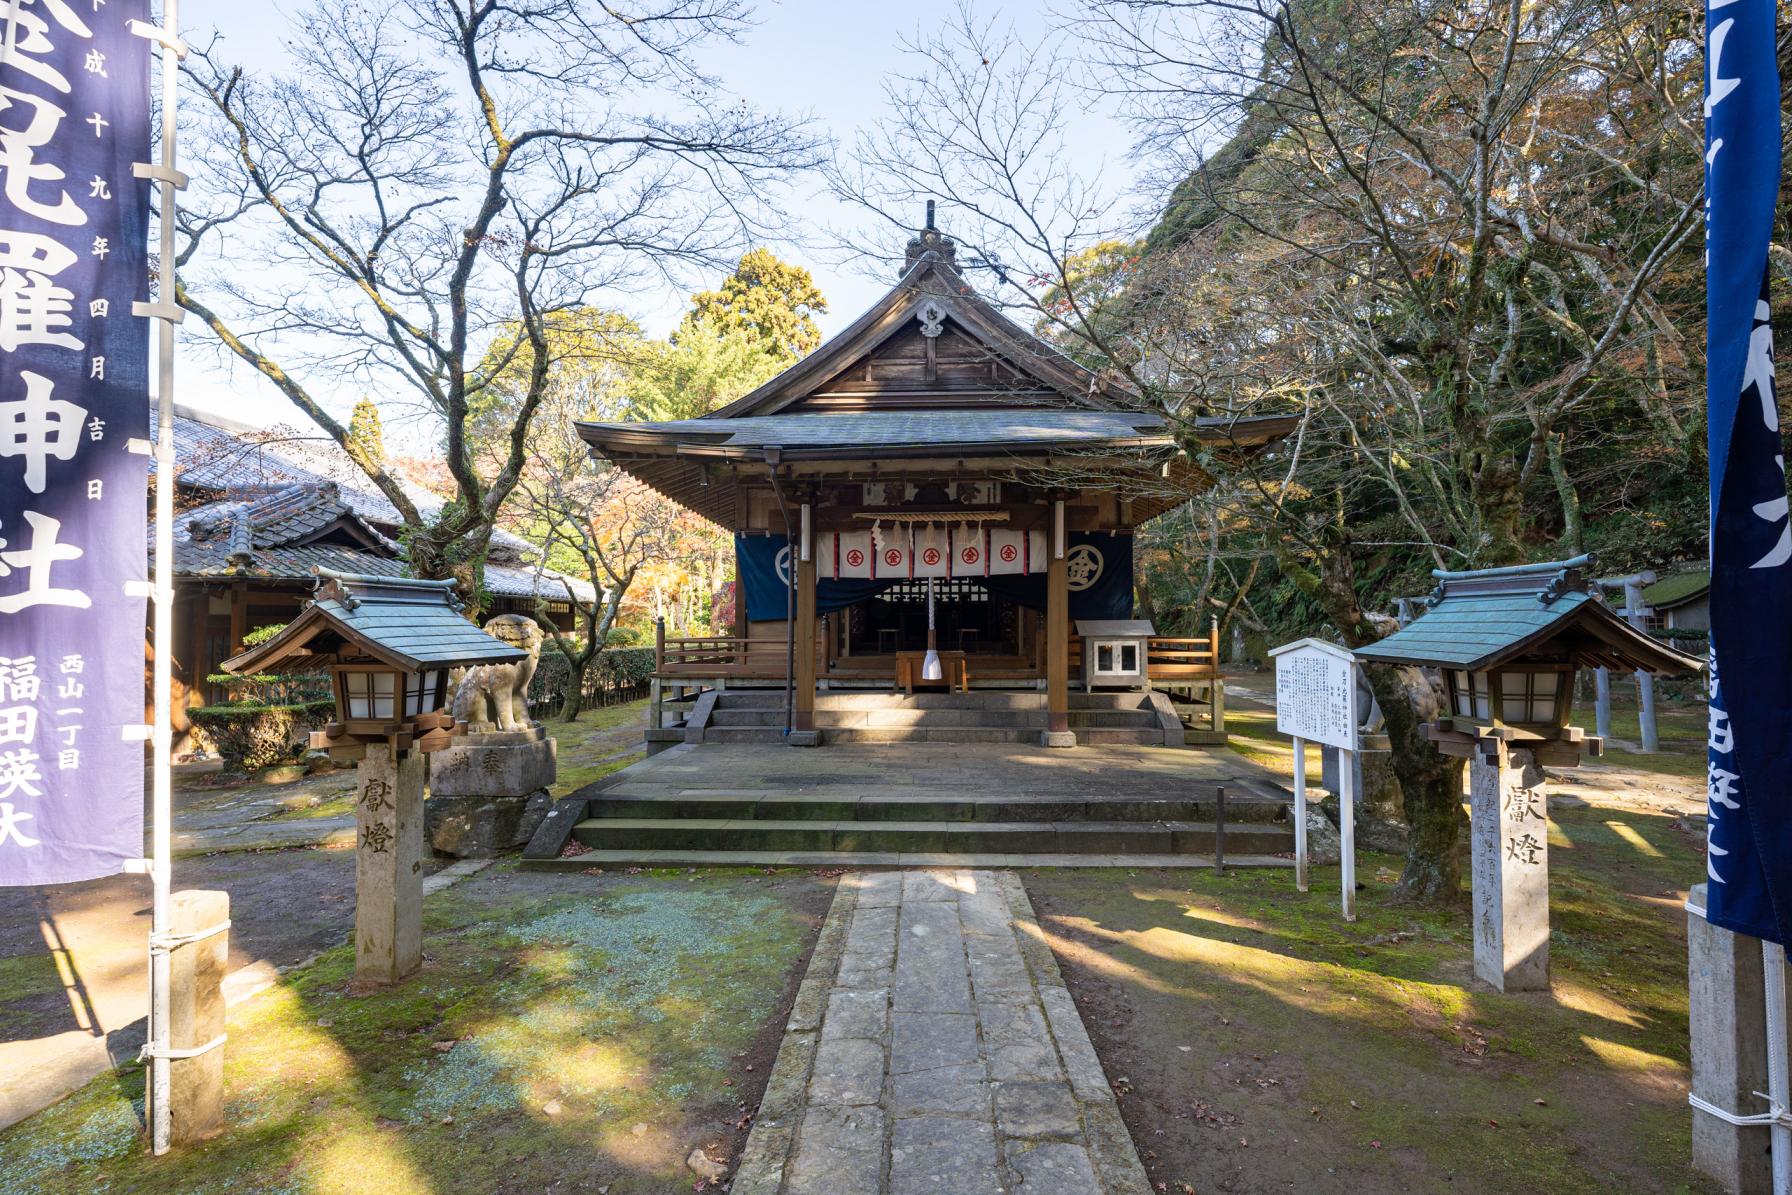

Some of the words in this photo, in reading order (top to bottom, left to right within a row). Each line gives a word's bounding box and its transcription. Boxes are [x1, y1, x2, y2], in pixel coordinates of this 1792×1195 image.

[849, 549, 862, 564] 金
[887, 549, 900, 564] 金
[925, 549, 938, 564] 金
[964, 548, 977, 563] 金
[1002, 545, 1015, 559] 金
[56, 654, 84, 770] 西山一丁目
